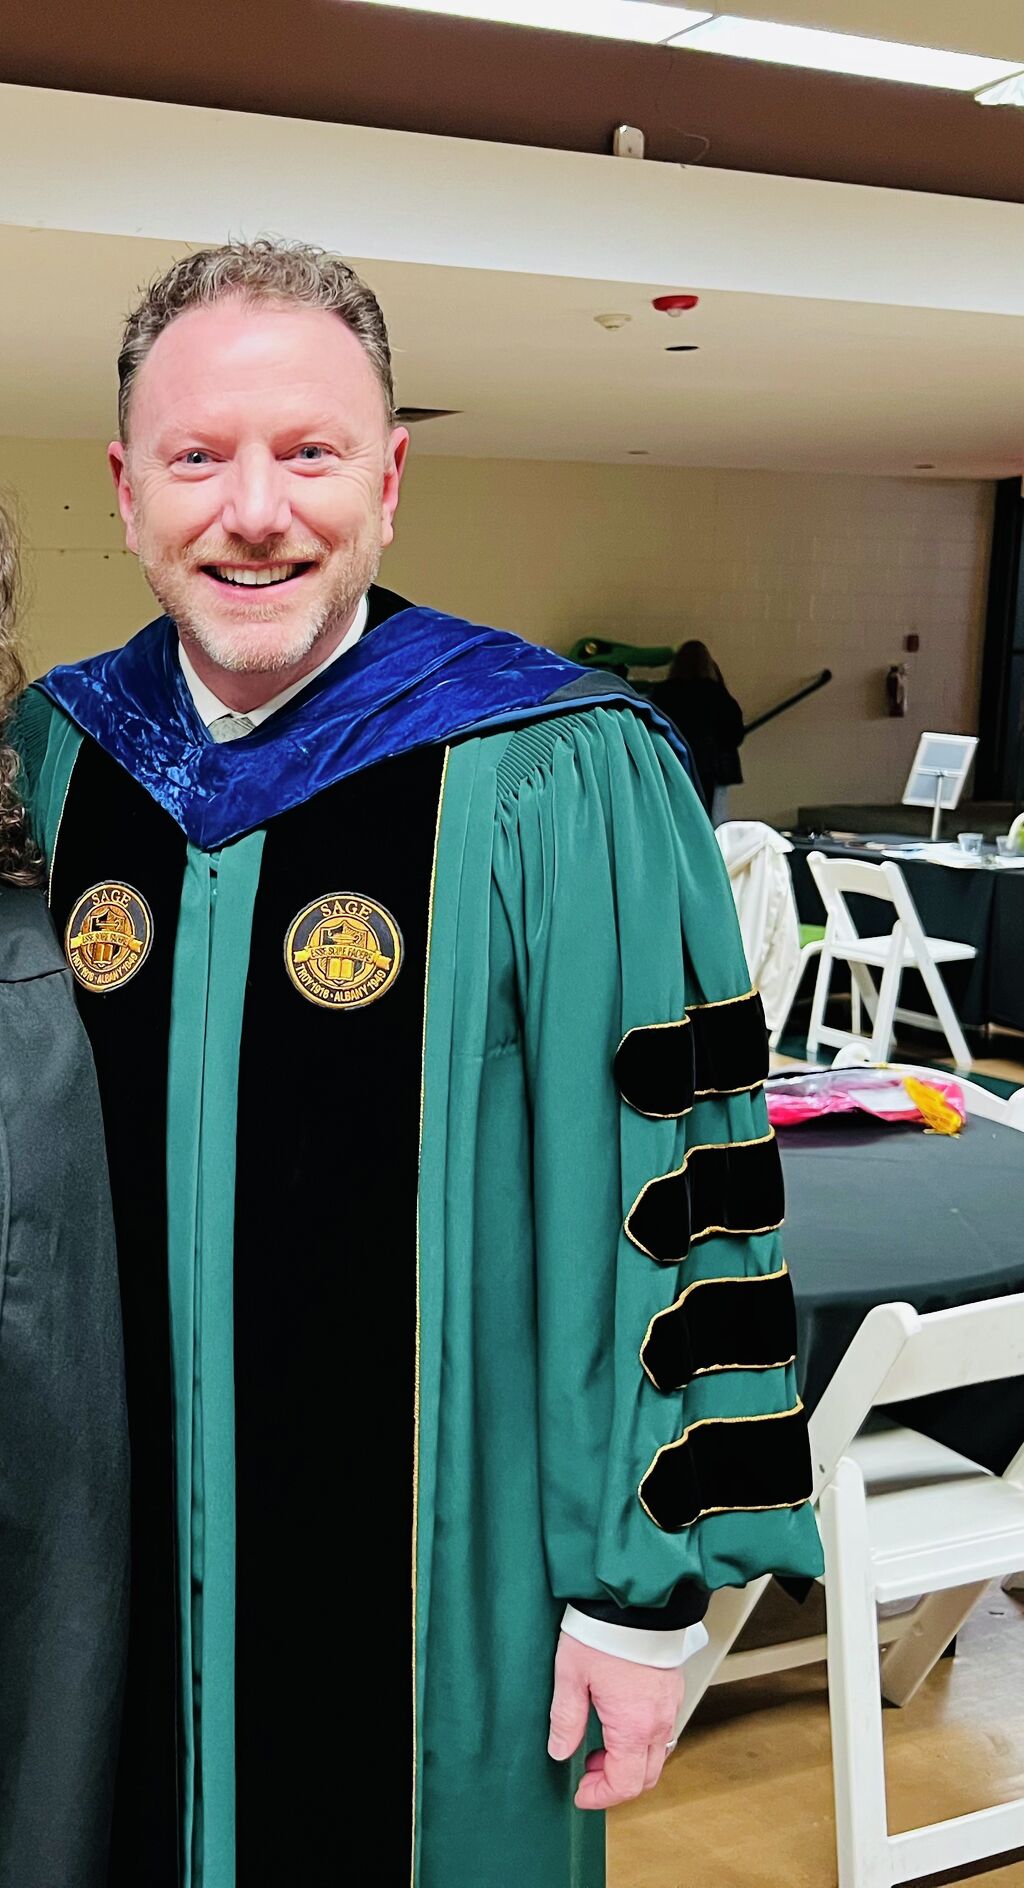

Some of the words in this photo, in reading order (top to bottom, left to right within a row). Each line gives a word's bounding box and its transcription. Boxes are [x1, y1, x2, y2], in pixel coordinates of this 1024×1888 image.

[91, 889, 132, 908] SAGE
[320, 900, 373, 921] SAGE
[97, 969, 124, 984] ALBANY
[295, 963, 313, 988] TROY
[333, 986, 370, 1002] ALBANY
[367, 969, 387, 991] 1949
